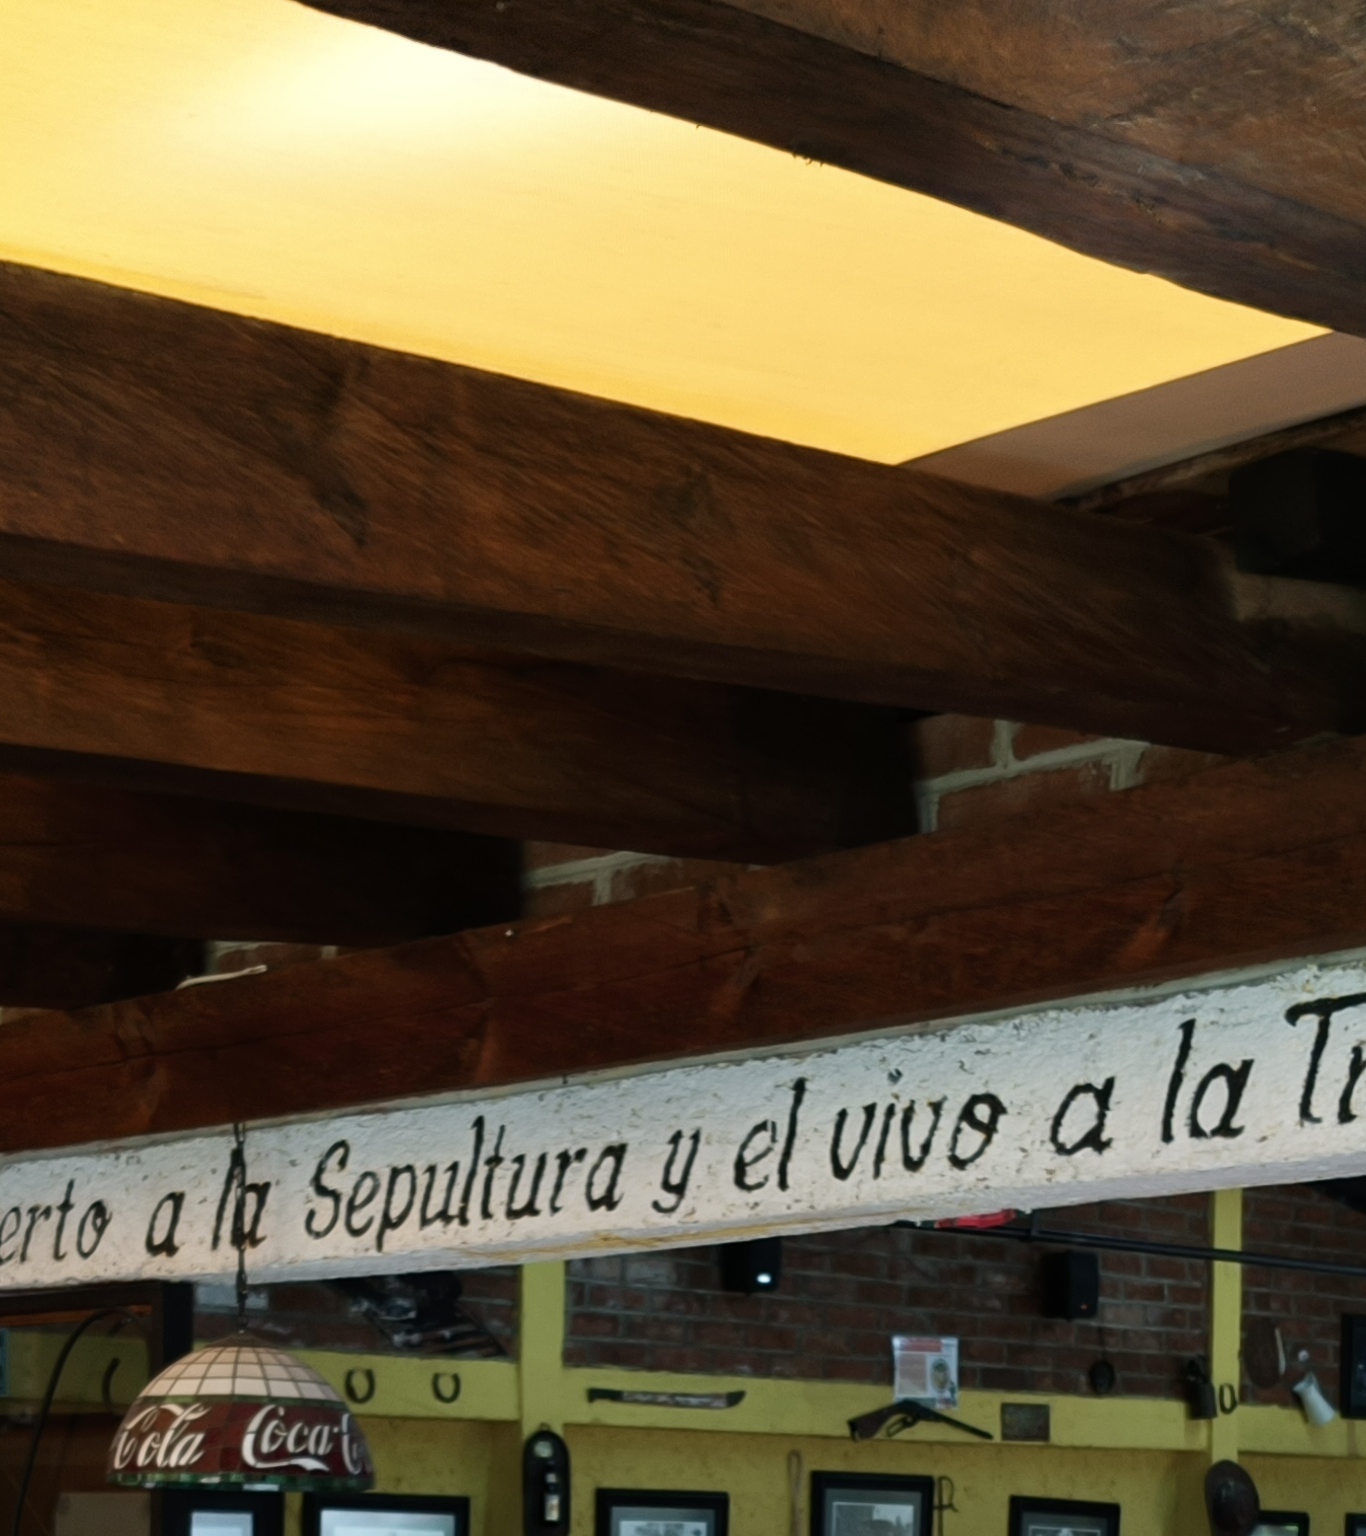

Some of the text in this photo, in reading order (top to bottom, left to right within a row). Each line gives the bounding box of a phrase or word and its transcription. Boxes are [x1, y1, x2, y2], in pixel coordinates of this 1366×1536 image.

[144, 1190, 186, 1258] a
[211, 1148, 273, 1252] la
[304, 1114, 629, 1253] Sepultura
[653, 1127, 702, 1214] y
[734, 1076, 807, 1193] el
[829, 1069, 1008, 1182] vivo
[1049, 1076, 1116, 1157] a
[1161, 1017, 1255, 1145] la
[113, 1402, 212, 1470] Cola
